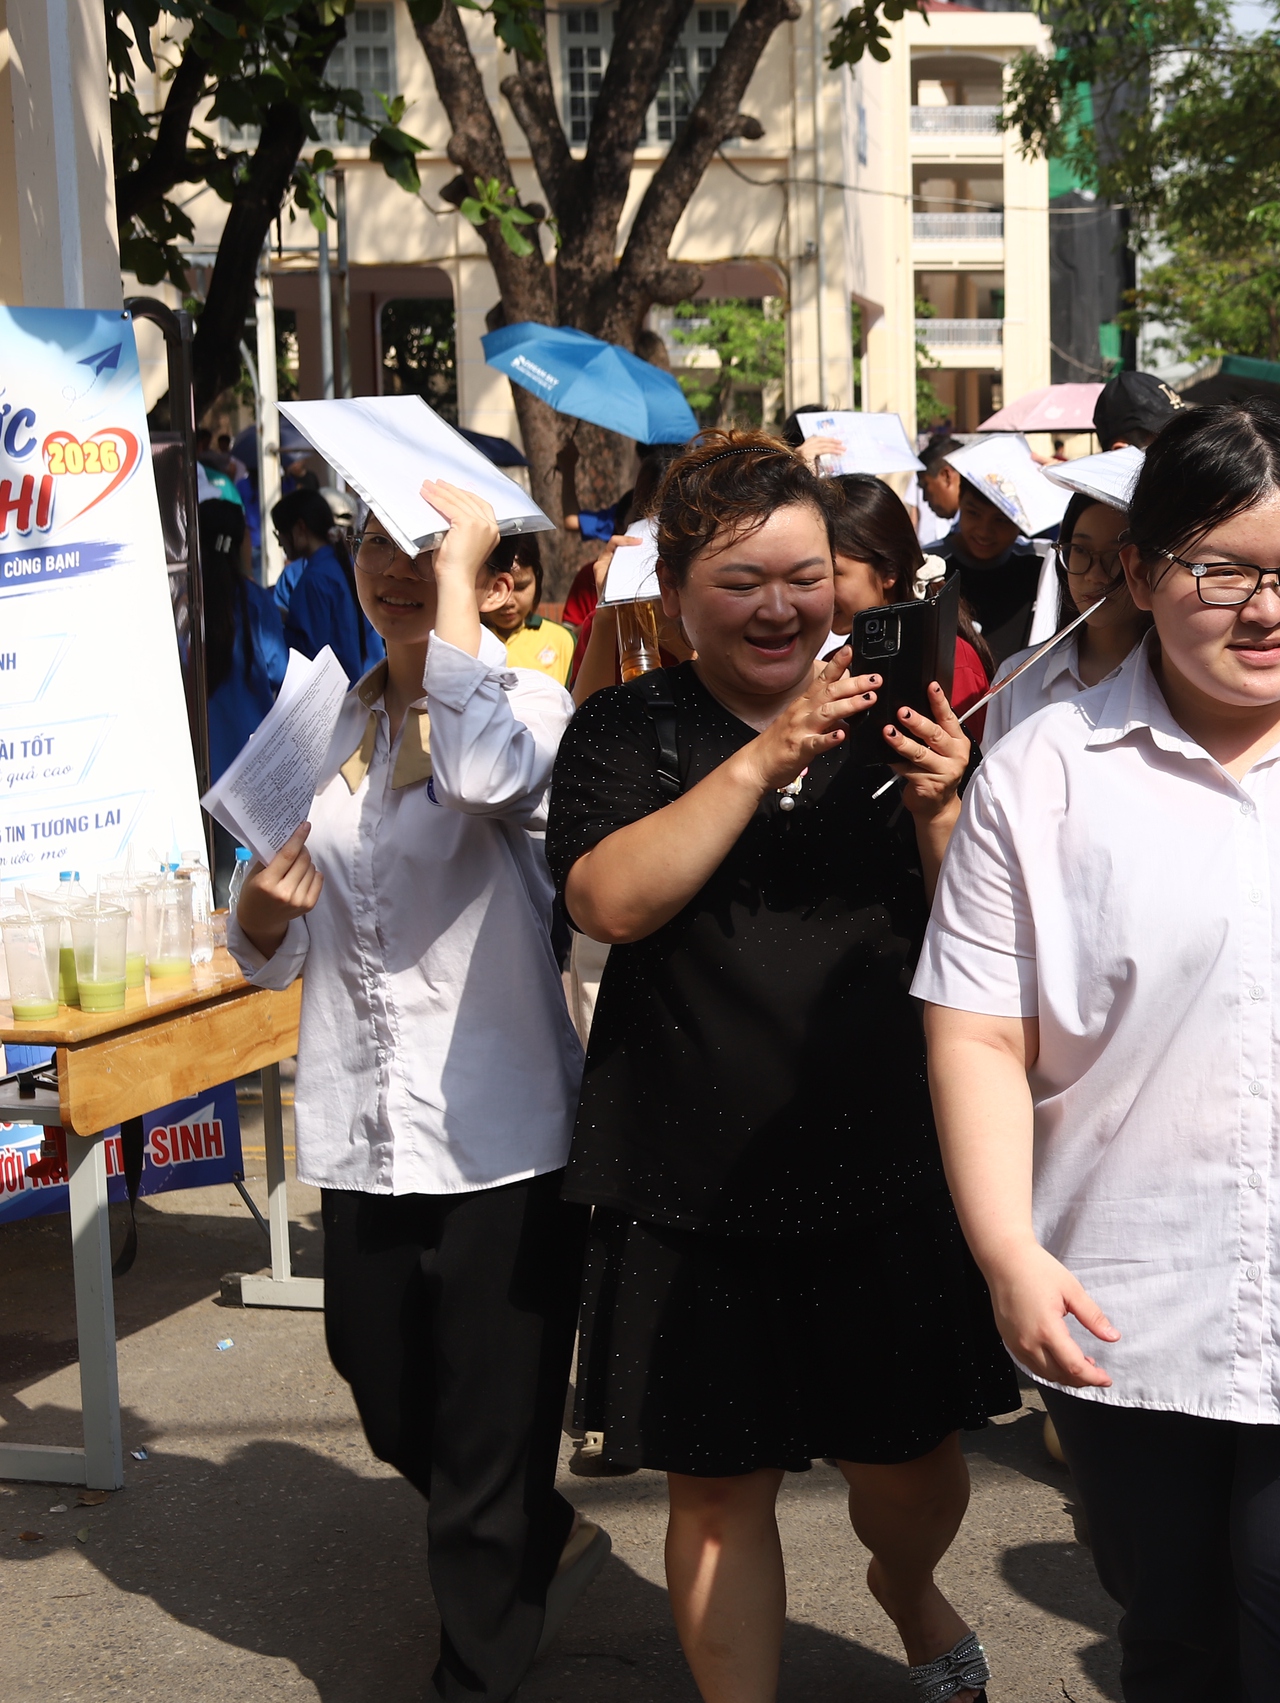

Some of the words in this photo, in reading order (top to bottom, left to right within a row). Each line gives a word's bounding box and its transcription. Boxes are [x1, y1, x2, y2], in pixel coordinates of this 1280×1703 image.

[47, 440, 120, 475] 2026
[4, 556, 42, 578] CÙNG
[45, 550, 80, 573] BẠN!
[20, 732, 55, 758] TỐT
[6, 765, 38, 789] quả
[43, 764, 73, 778] cao
[5, 825, 26, 843] TIN
[31, 815, 89, 840] TƯƠNG
[94, 808, 121, 830] LAI
[40, 846, 68, 861] mơ
[150, 1121, 224, 1167] SINH
[0, 1146, 25, 1195] ỜI
